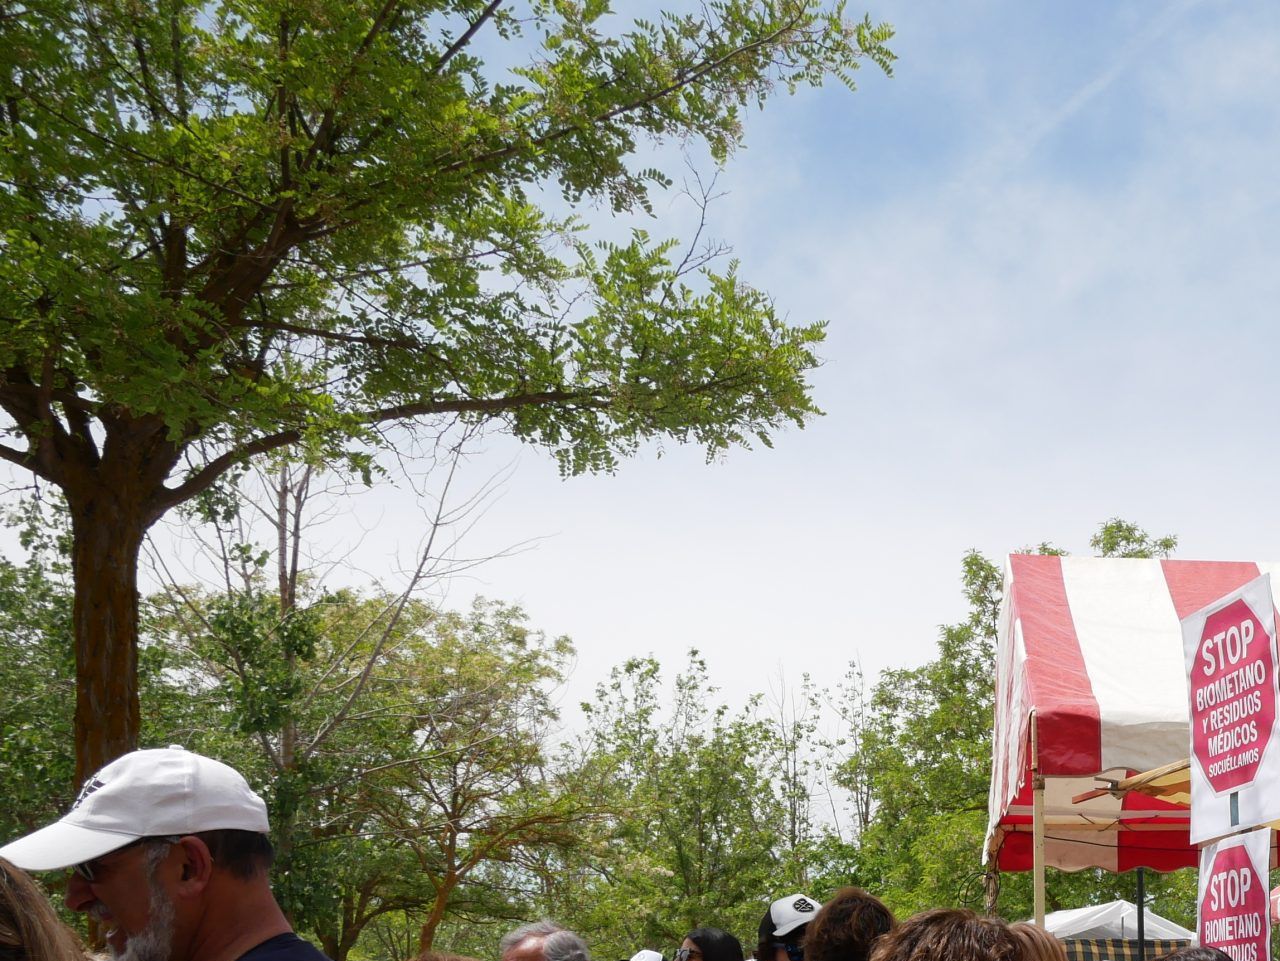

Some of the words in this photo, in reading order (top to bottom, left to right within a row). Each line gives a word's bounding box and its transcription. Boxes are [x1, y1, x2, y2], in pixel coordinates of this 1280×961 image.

[1202, 619, 1254, 676] STOP
[1196, 659, 1266, 711] BIOMETANO
[1202, 717, 1209, 734] Y
[1210, 690, 1262, 732] RESIDUOS
[1208, 720, 1258, 758] MÉDICOS
[1208, 747, 1259, 778] SOCUÉLLAMOS
[1210, 867, 1251, 912] STOP
[1205, 912, 1261, 944] BIOMETANO
